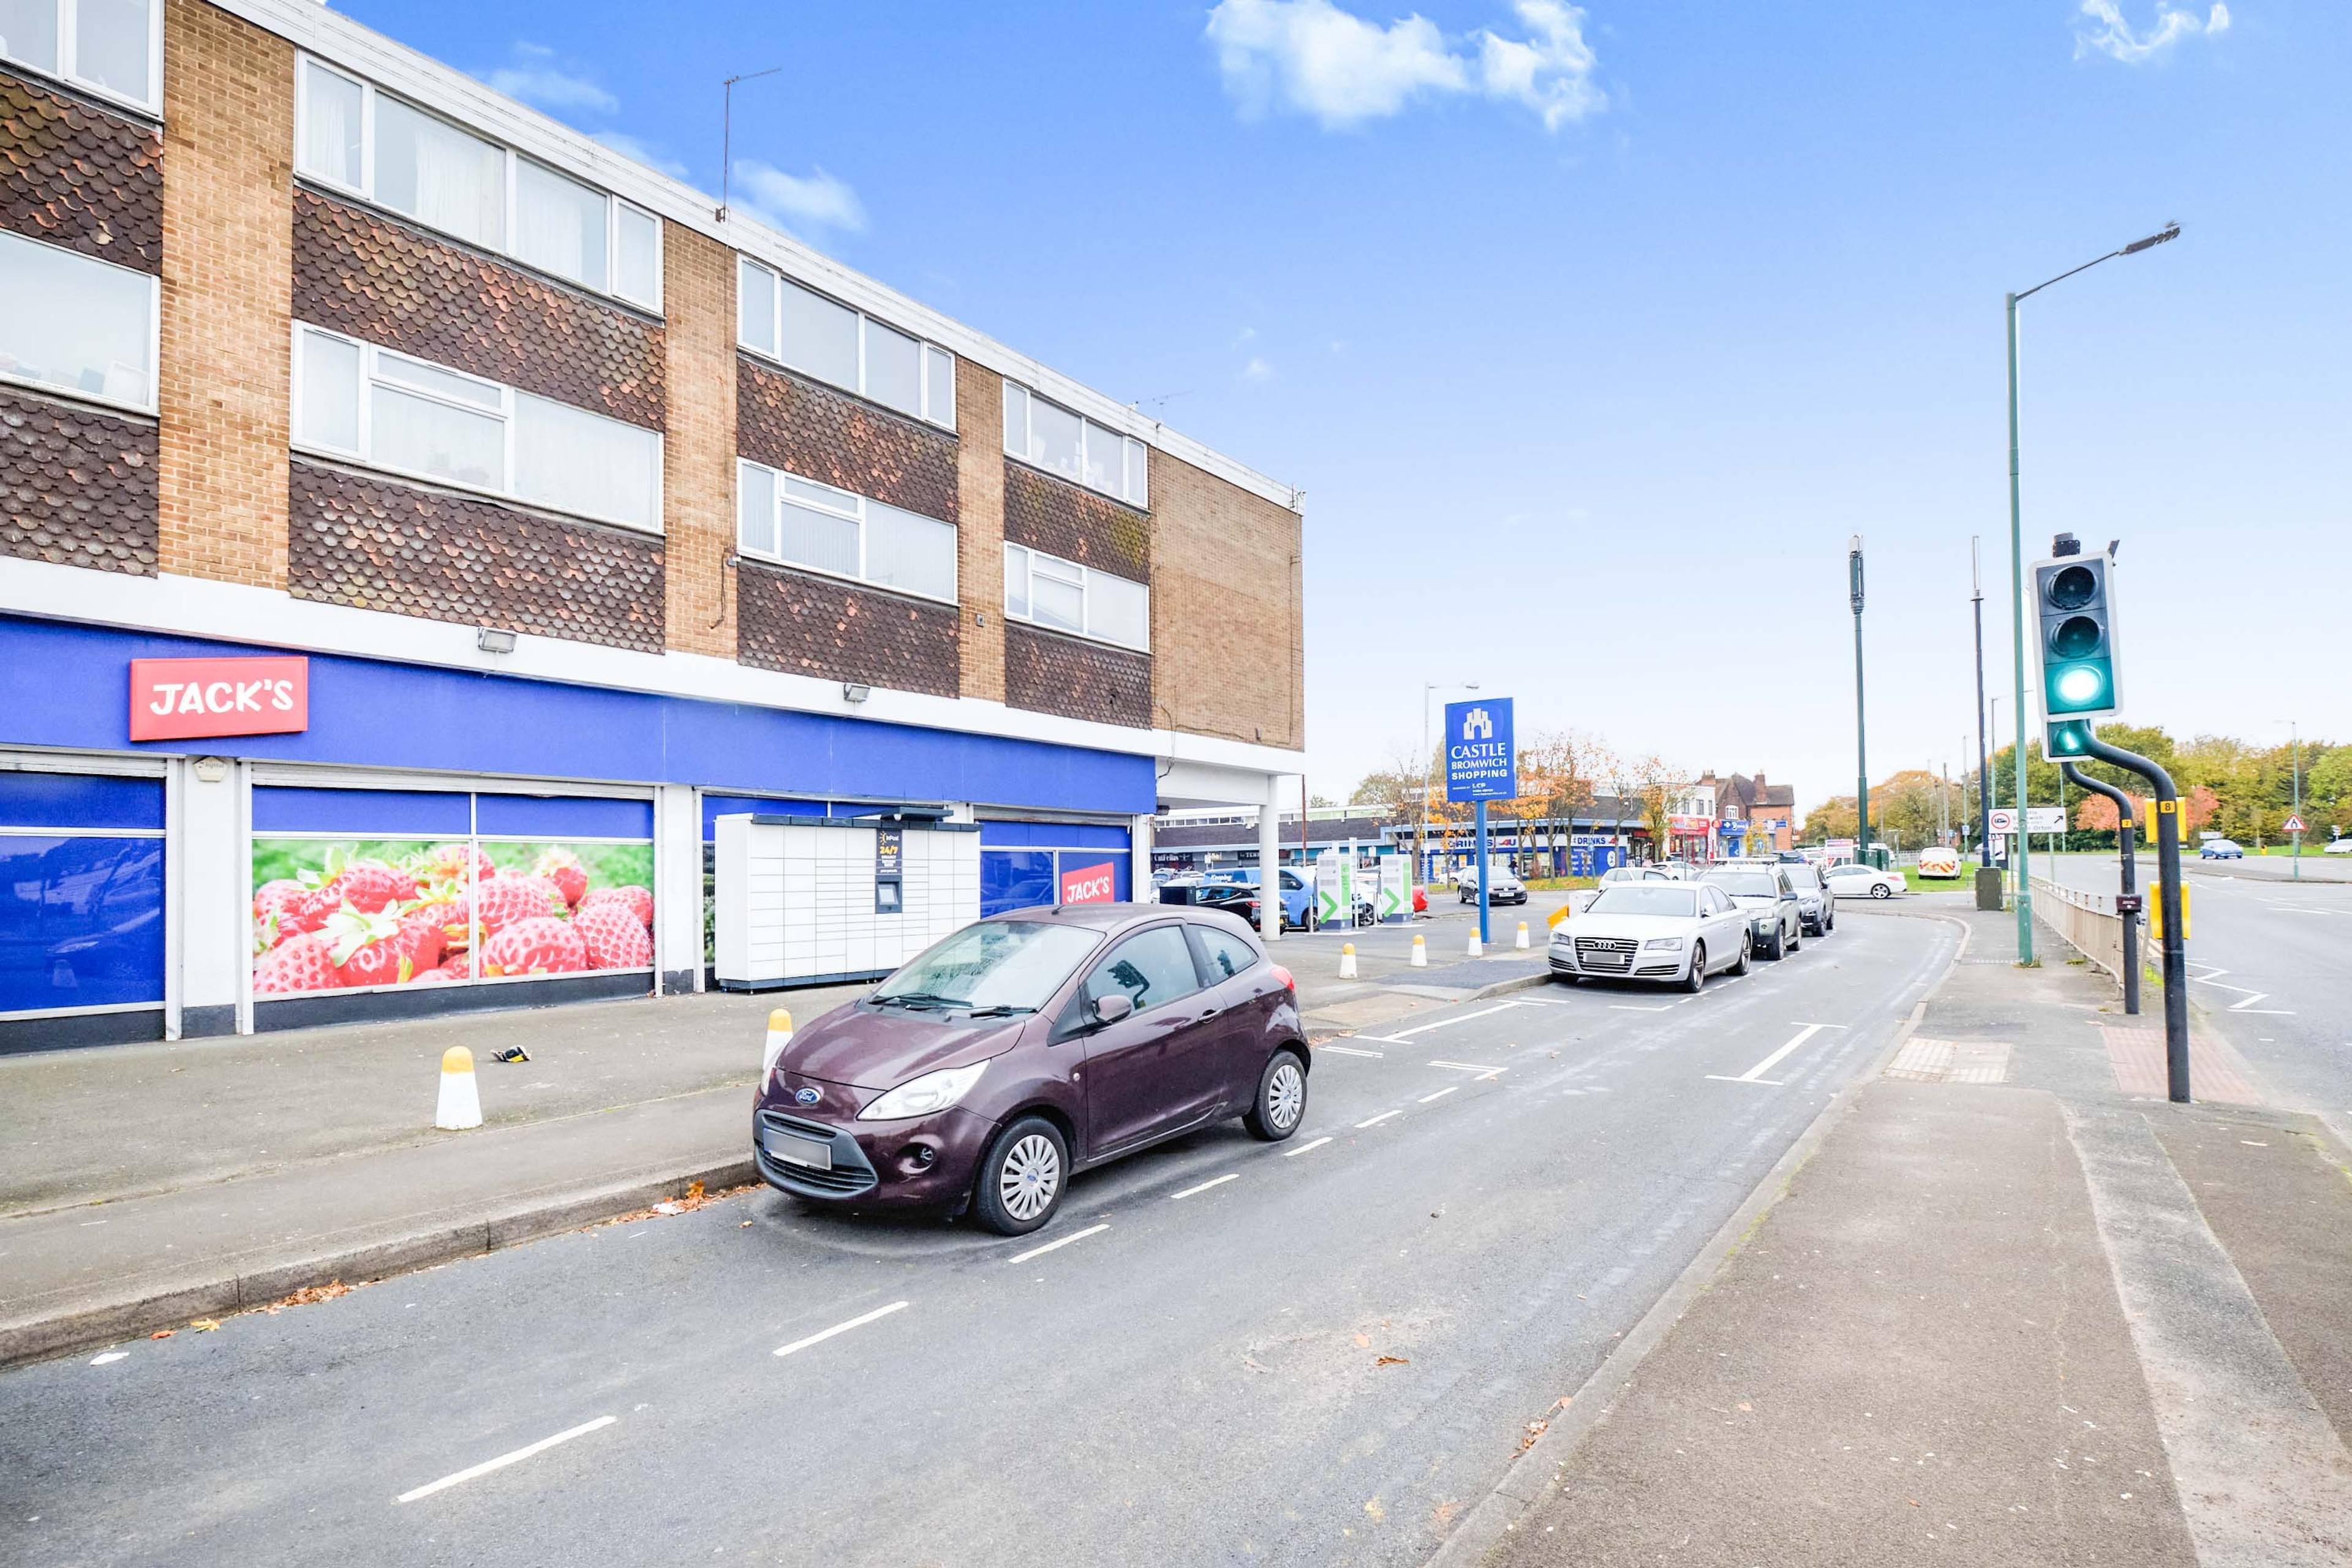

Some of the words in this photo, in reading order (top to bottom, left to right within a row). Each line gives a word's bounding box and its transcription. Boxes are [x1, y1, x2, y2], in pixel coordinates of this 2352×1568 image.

[150, 679, 293, 715] JACK'S
[1451, 742, 1506, 759] CASTLE
[1451, 758, 1507, 770] BROMWICH
[1451, 769, 1507, 780] SHOPPING
[2165, 802, 2171, 811] 8
[880, 845, 898, 854] 24/7
[1067, 875, 1110, 903] JACK'S
